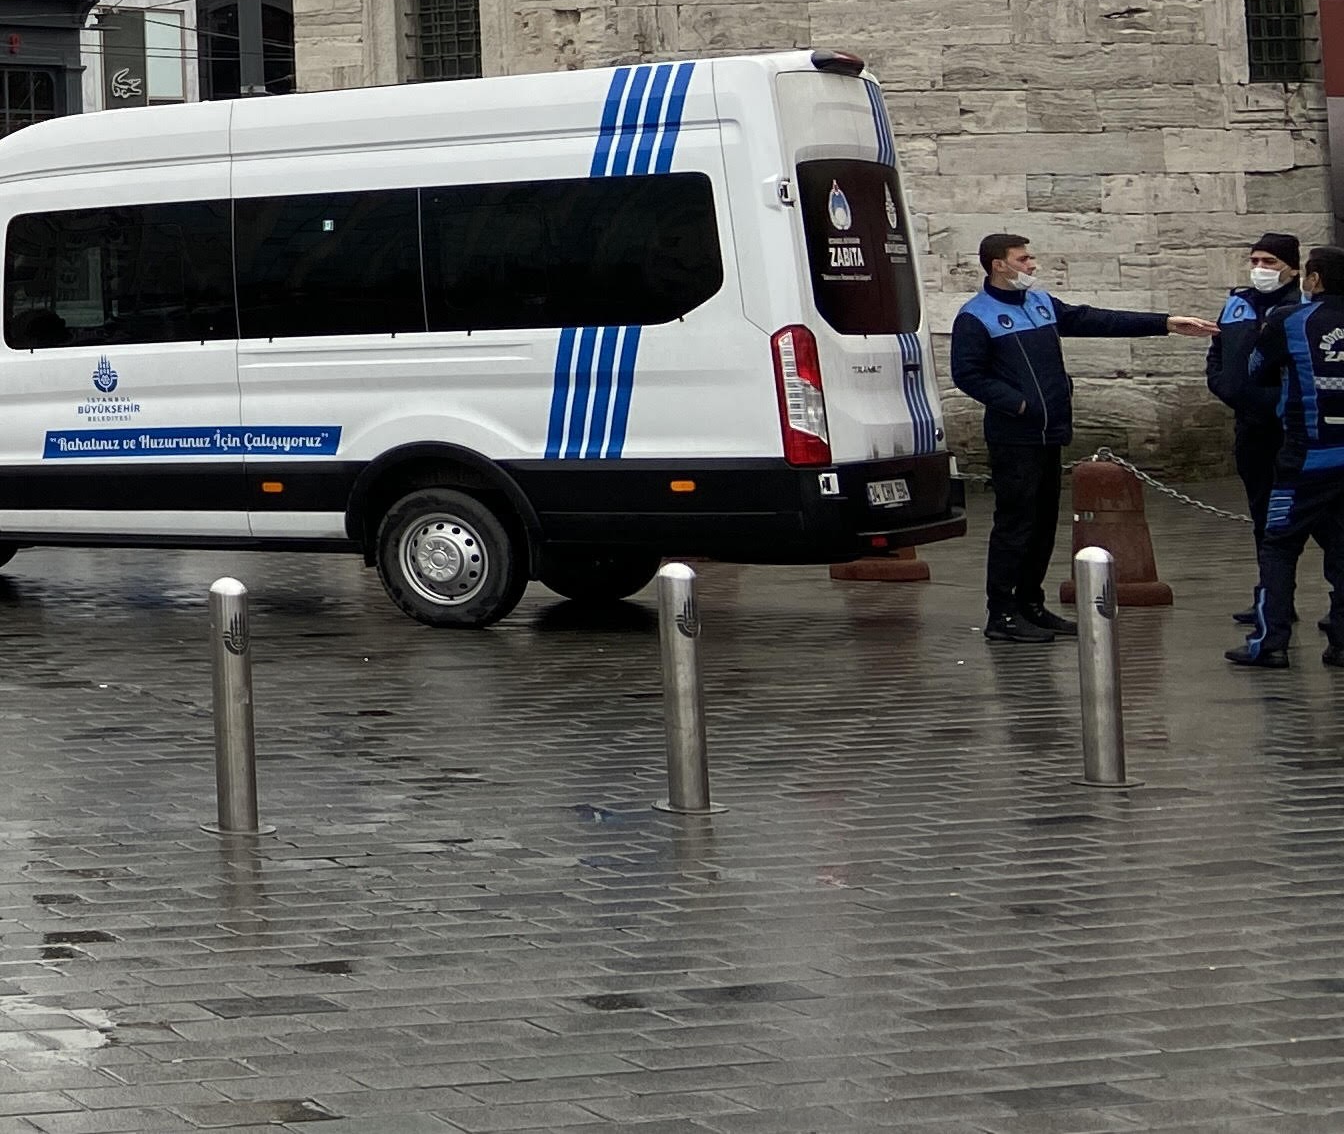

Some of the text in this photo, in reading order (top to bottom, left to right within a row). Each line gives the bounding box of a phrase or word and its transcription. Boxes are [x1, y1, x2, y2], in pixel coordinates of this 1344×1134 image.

[829, 247, 865, 267] ZABITA
[78, 403, 141, 415] BÜYÜKŞEHİR
[123, 440, 136, 450] ve
[139, 434, 211, 449] Huzurunuz
[213, 429, 240, 449] İçin
